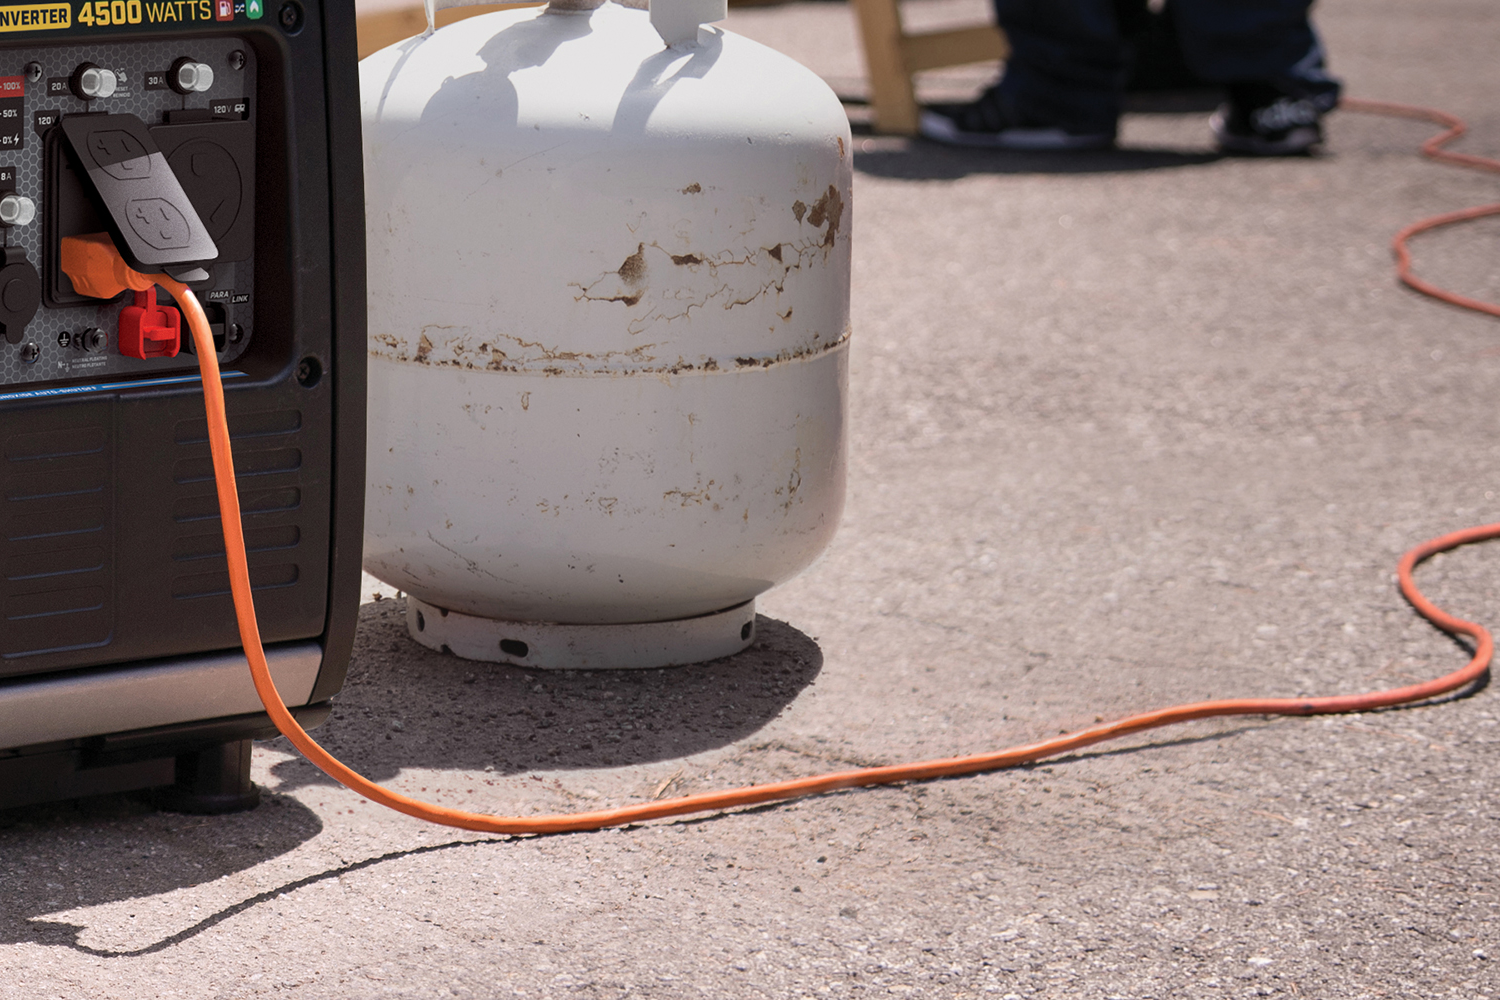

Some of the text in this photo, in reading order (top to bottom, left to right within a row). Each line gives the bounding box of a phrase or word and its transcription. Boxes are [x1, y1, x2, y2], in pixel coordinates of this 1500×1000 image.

[145, 0, 212, 23] WATTS
[210, 291, 229, 299] PARA
[231, 295, 249, 303] LINK
[35, 386, 97, 396] AUTO-SHUTOFF
